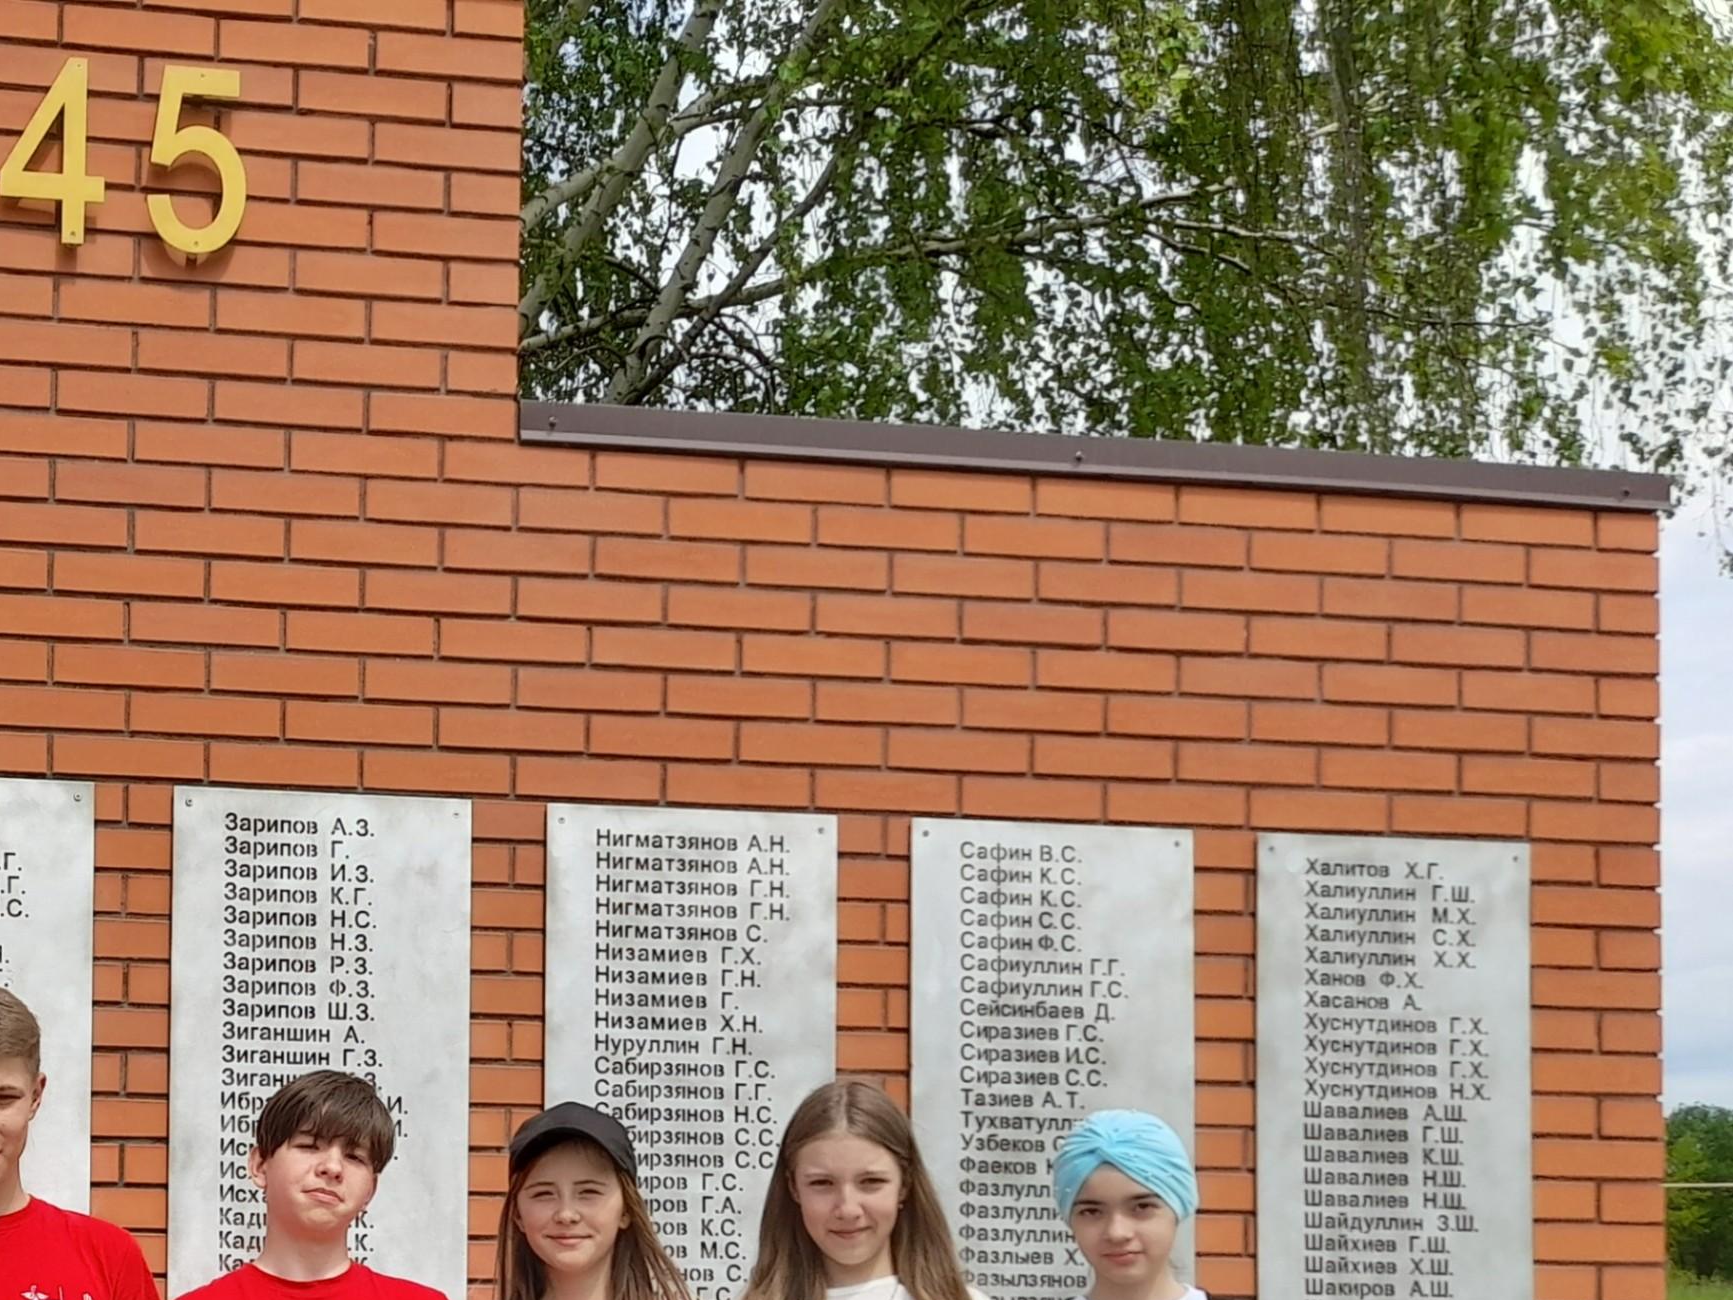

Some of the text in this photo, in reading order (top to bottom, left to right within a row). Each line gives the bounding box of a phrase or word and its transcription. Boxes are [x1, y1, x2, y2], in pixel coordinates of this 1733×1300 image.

[225, 812, 374, 837] Зарипов А.З.
[224, 835, 350, 860] Зарипов Г.
[595, 828, 791, 853] Нигматзянов А.Н.
[959, 841, 1082, 865] Сафин В.С.
[224, 858, 374, 883] Зарипов И.З.
[1303, 858, 1391, 878] Халитов
[224, 882, 372, 906] Зарипов К.Г.
[594, 874, 791, 899] Нигматзянов Г.Н.
[1305, 880, 1417, 904] Халиуллин
[223, 905, 377, 930] Зарипов Н.С.
[959, 908, 1081, 932] Сафин С.С.
[1305, 902, 1416, 926] Халиуллин
[595, 919, 767, 943] Нигматзянов С.
[960, 930, 1082, 954] Сафин Ф.С.
[595, 942, 761, 966] Низамиев Г.Х.
[960, 952, 1125, 978] Сафиуллин Г.Г.
[222, 975, 375, 999] Зарипов Ф.З.
[595, 965, 761, 988] Низамиев Г.Н.
[1305, 968, 1367, 987] Ханов
[222, 998, 375, 1022] Зарипов Ш.З.
[595, 988, 739, 1010] Низамиев Г.
[960, 997, 1115, 1024] Сейсинбаев Д.
[1305, 990, 1390, 1010] Хасанов
[222, 1021, 365, 1044] Зиганшин А.
[593, 1010, 763, 1034] Низамиев Х.Н.
[222, 1044, 383, 1068] Зиганшин Г.З.
[594, 1033, 753, 1057] Нуруллин Г.Н.
[960, 1042, 1107, 1066] Сиразиев И.С.
[594, 1056, 775, 1080] Сабирзянов Г.С.
[959, 1065, 1108, 1089] Сиразиев С.С.
[961, 1088, 1085, 1110] Тазиев А.Т.
[1303, 1100, 1409, 1120] Шавалиев
[1303, 1145, 1409, 1164] Шавалиев
[1304, 1211, 1424, 1234] Шайдуллин
[1304, 1256, 1398, 1275] Шайхиев
[1305, 1278, 1396, 1300] Шакиров
